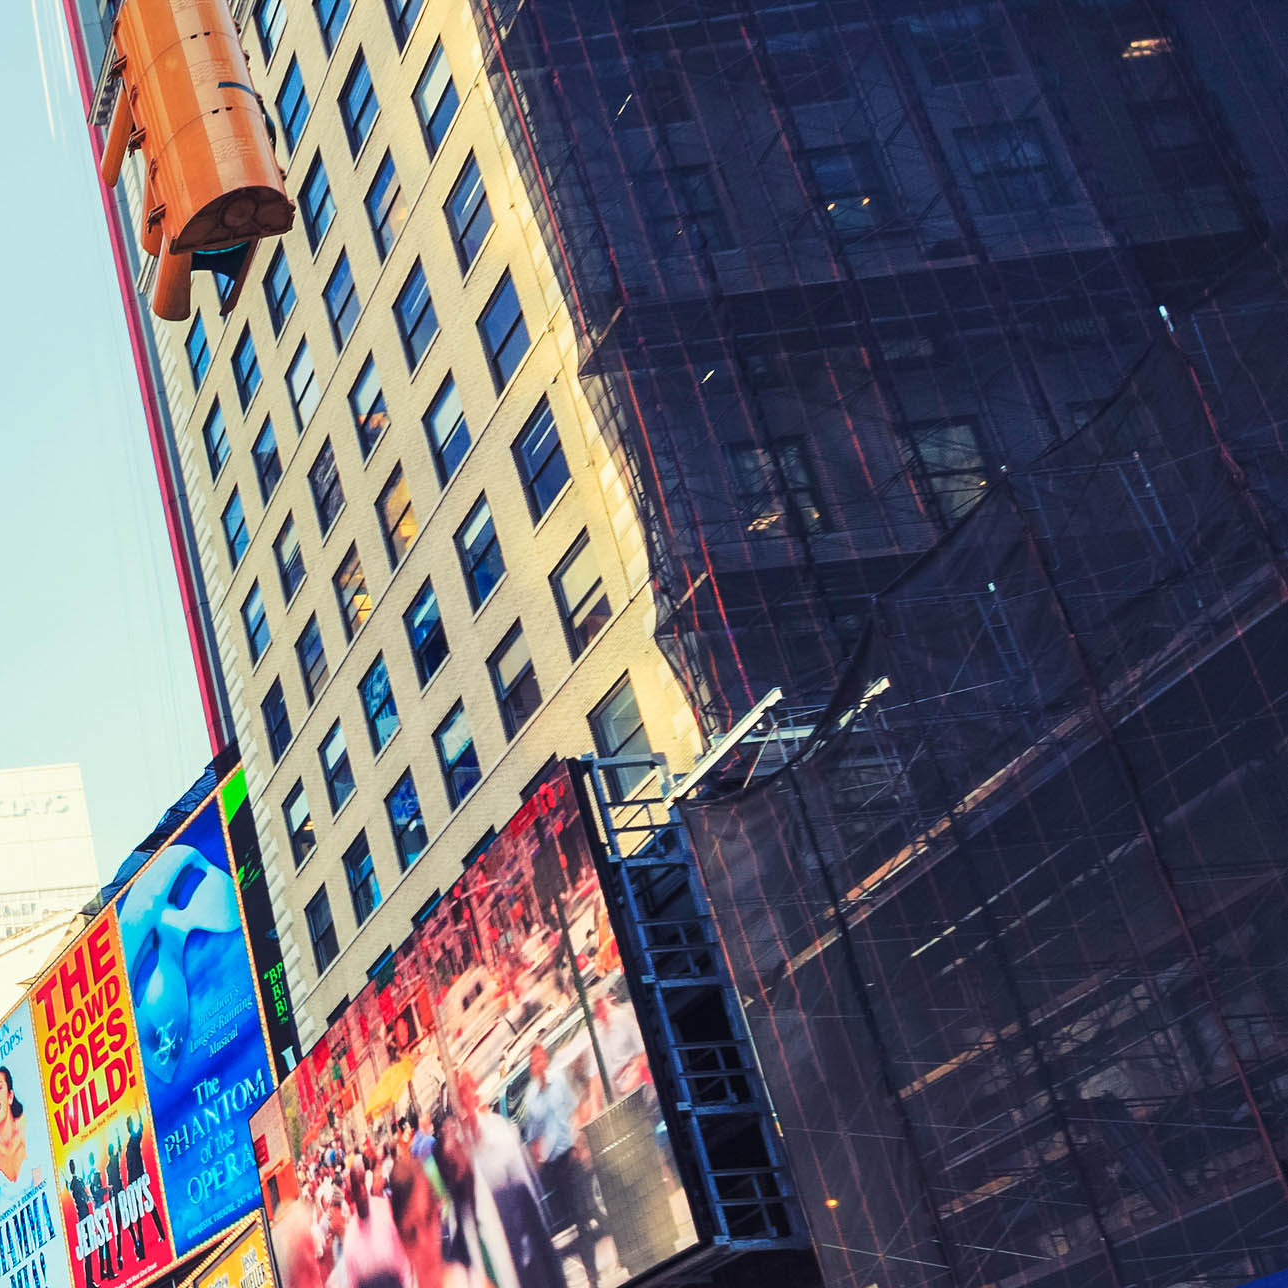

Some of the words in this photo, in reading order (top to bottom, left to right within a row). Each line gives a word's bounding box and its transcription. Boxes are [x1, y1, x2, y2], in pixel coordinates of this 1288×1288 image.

[35, 916, 116, 1019] THE
[44, 974, 120, 1065] CROWD
[49, 1010, 128, 1103] GOES
[209, 1023, 239, 1058] Musical
[54, 1052, 136, 1146] WILD!
[164, 1068, 267, 1165] PHANTOM
[192, 1074, 220, 1105] The
[76, 1197, 120, 1262] JERSEY
[119, 1173, 154, 1231] BOYS
[187, 1141, 257, 1205] OPERA
